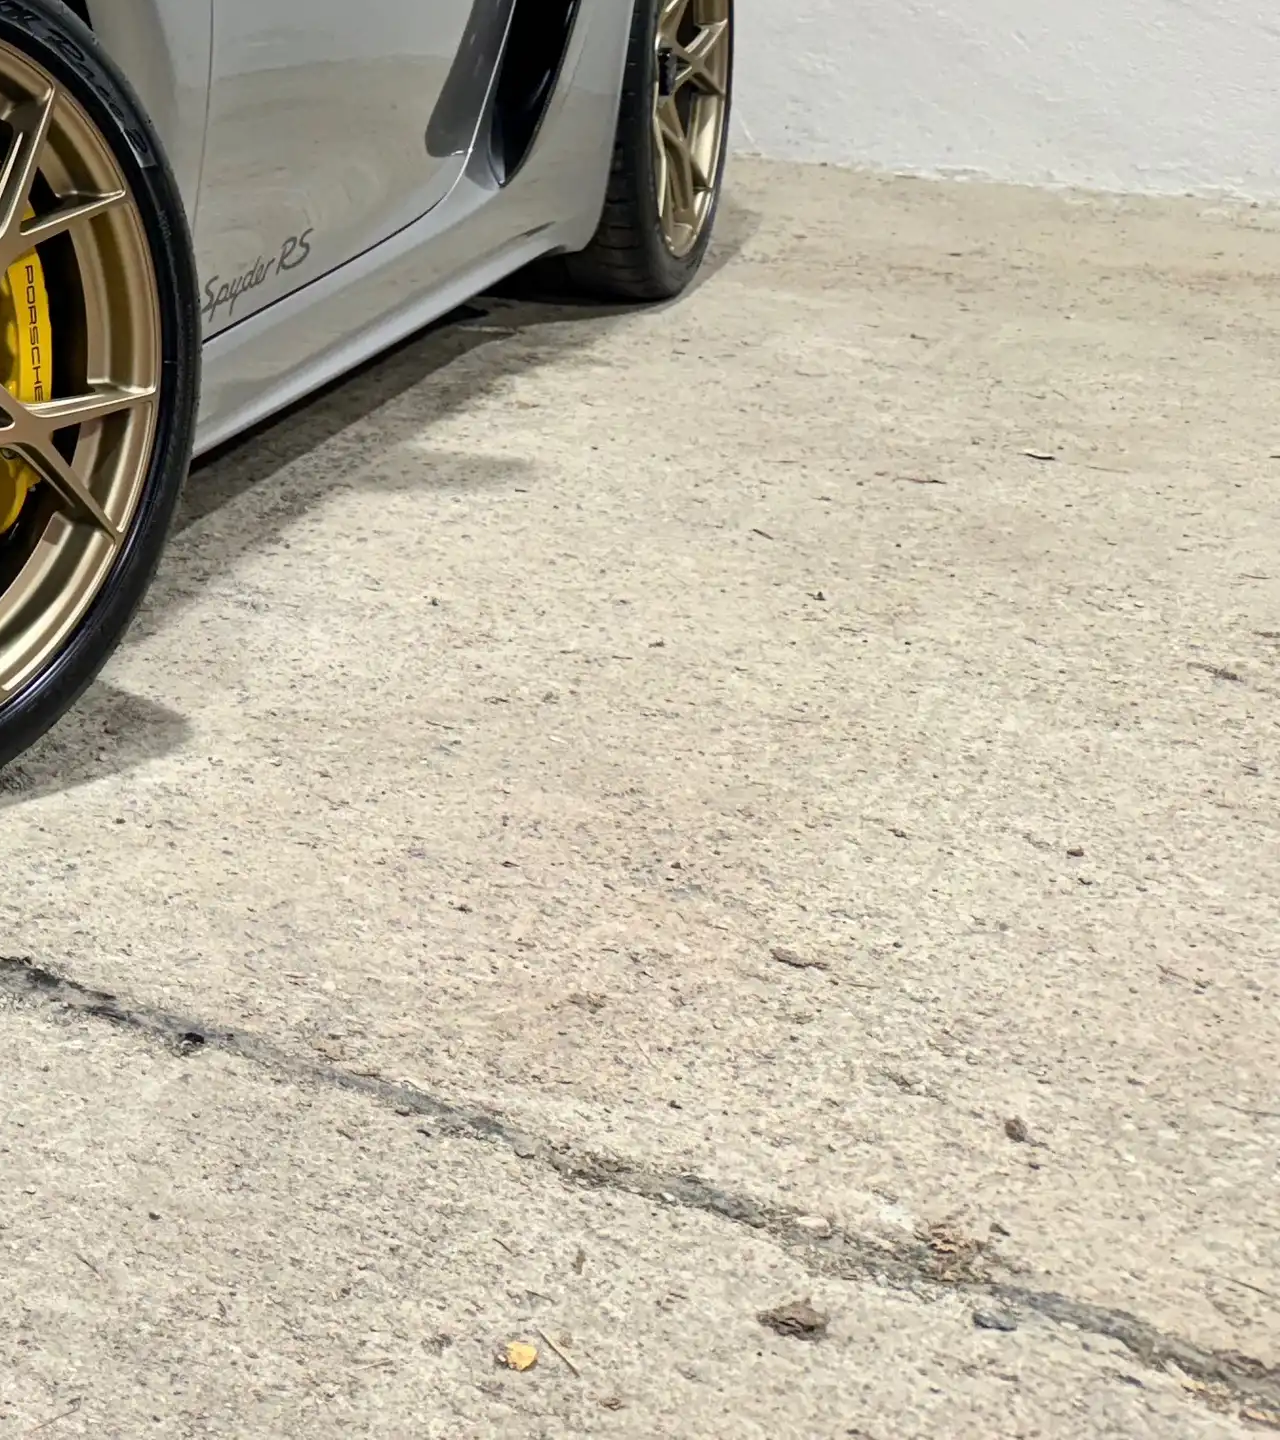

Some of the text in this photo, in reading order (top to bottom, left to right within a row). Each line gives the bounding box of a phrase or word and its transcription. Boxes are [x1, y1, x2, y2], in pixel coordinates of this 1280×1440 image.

[25, 265, 44, 401] PORSCHE
[201, 228, 314, 323] Spyder RS
